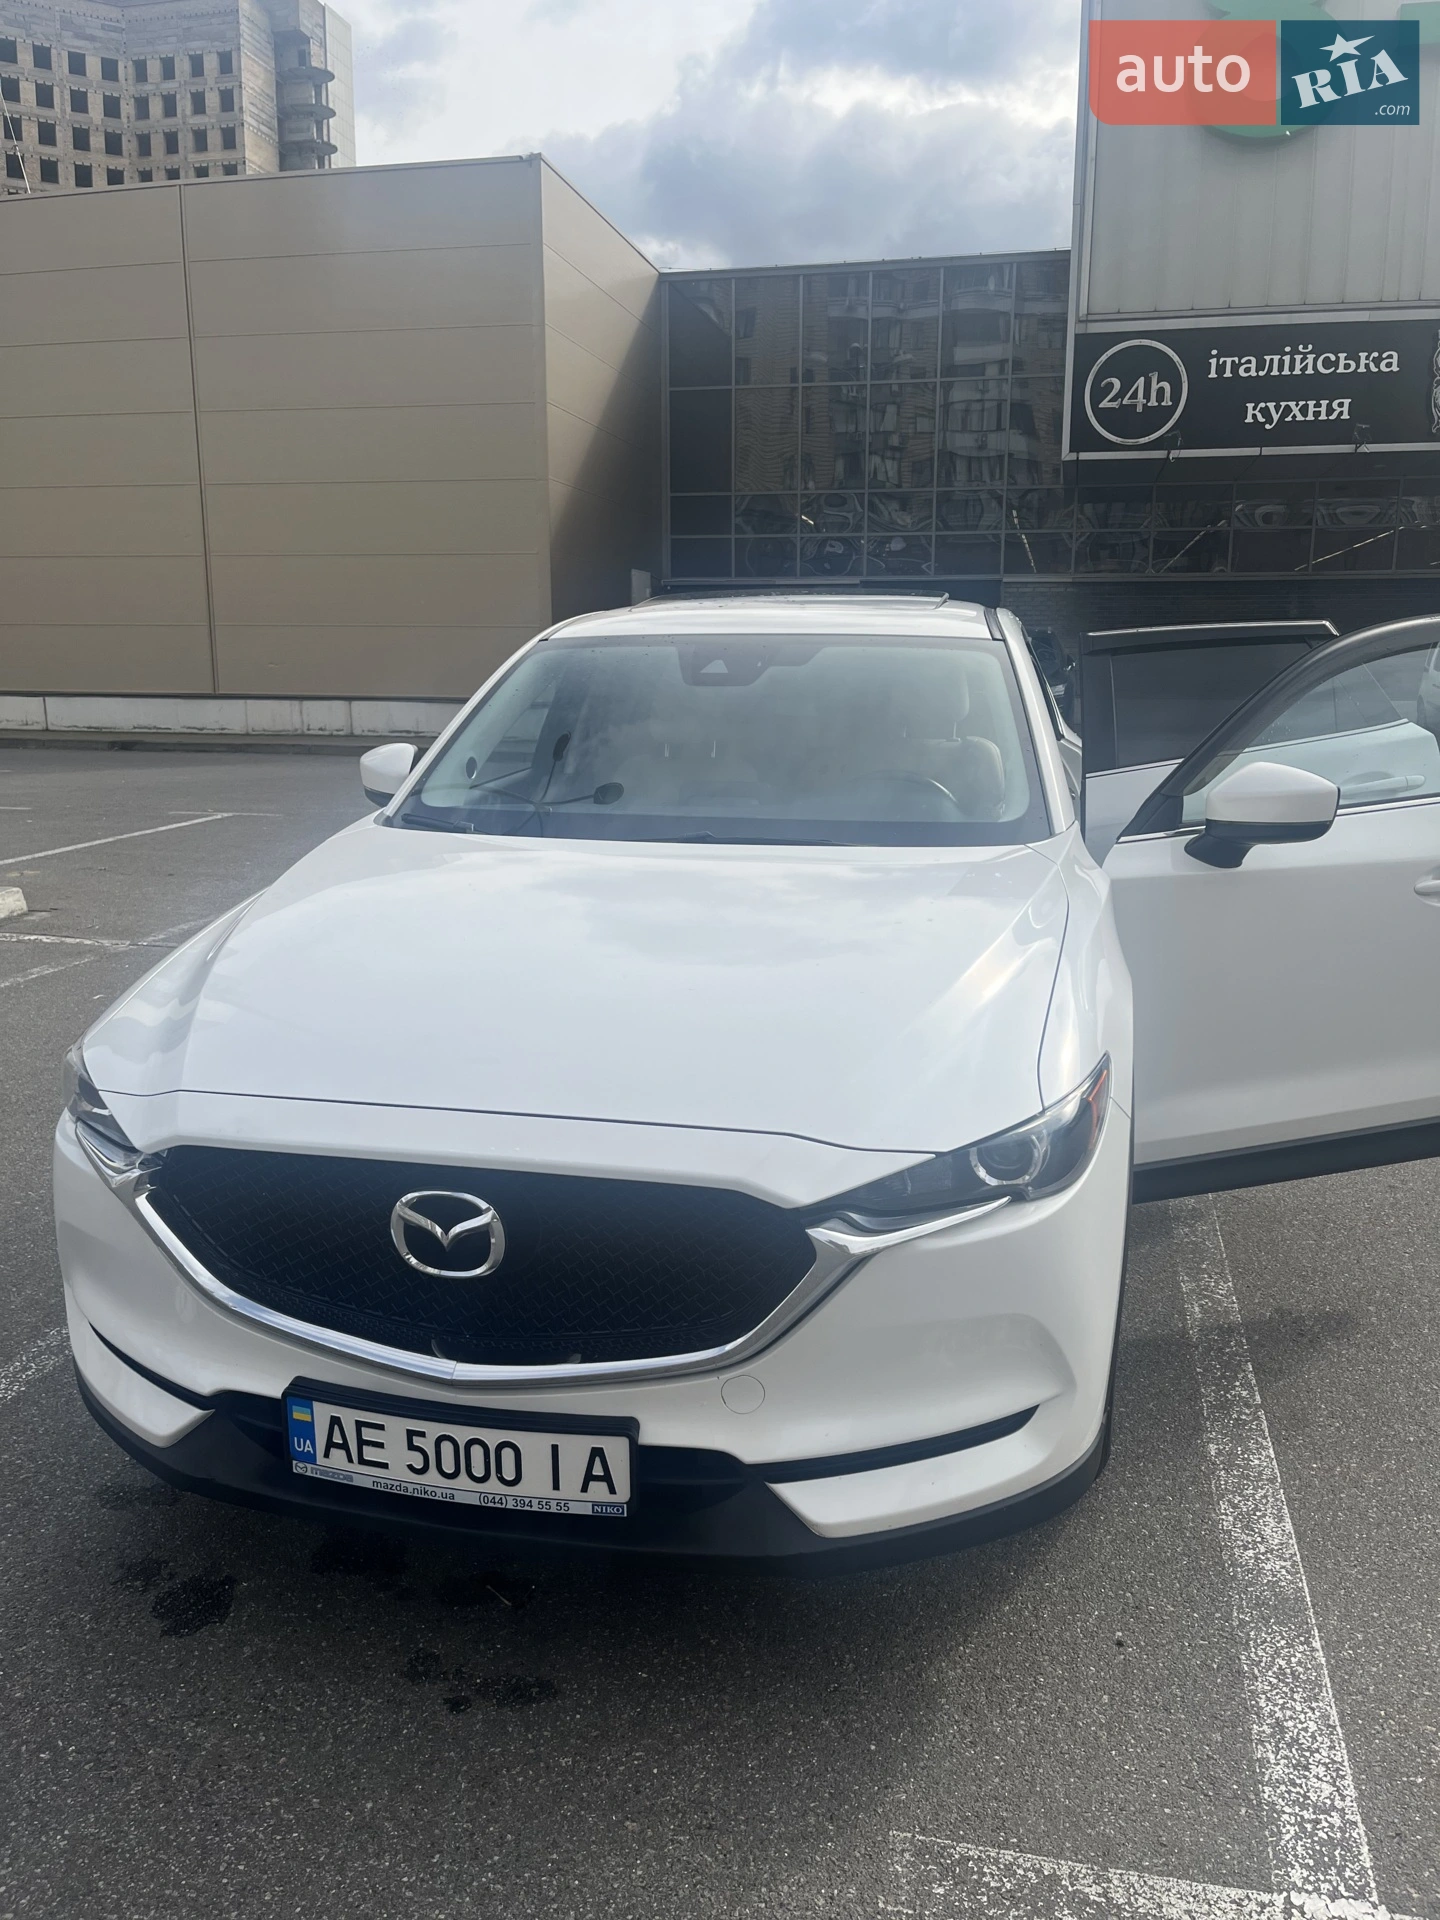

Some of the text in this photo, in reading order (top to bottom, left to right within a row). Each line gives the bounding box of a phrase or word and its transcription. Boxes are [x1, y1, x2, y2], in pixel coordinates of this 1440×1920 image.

[1208, 344, 1400, 378] італійська
[1098, 371, 1173, 412] 24h
[1244, 399, 1352, 429] кухня
[294, 1437, 314, 1454] UA
[323, 1414, 618, 1495] AE 5000 IA
[372, 1479, 570, 1512] mazda.niko.ua (044) 394 55 55
[593, 1504, 623, 1515] NIKO
